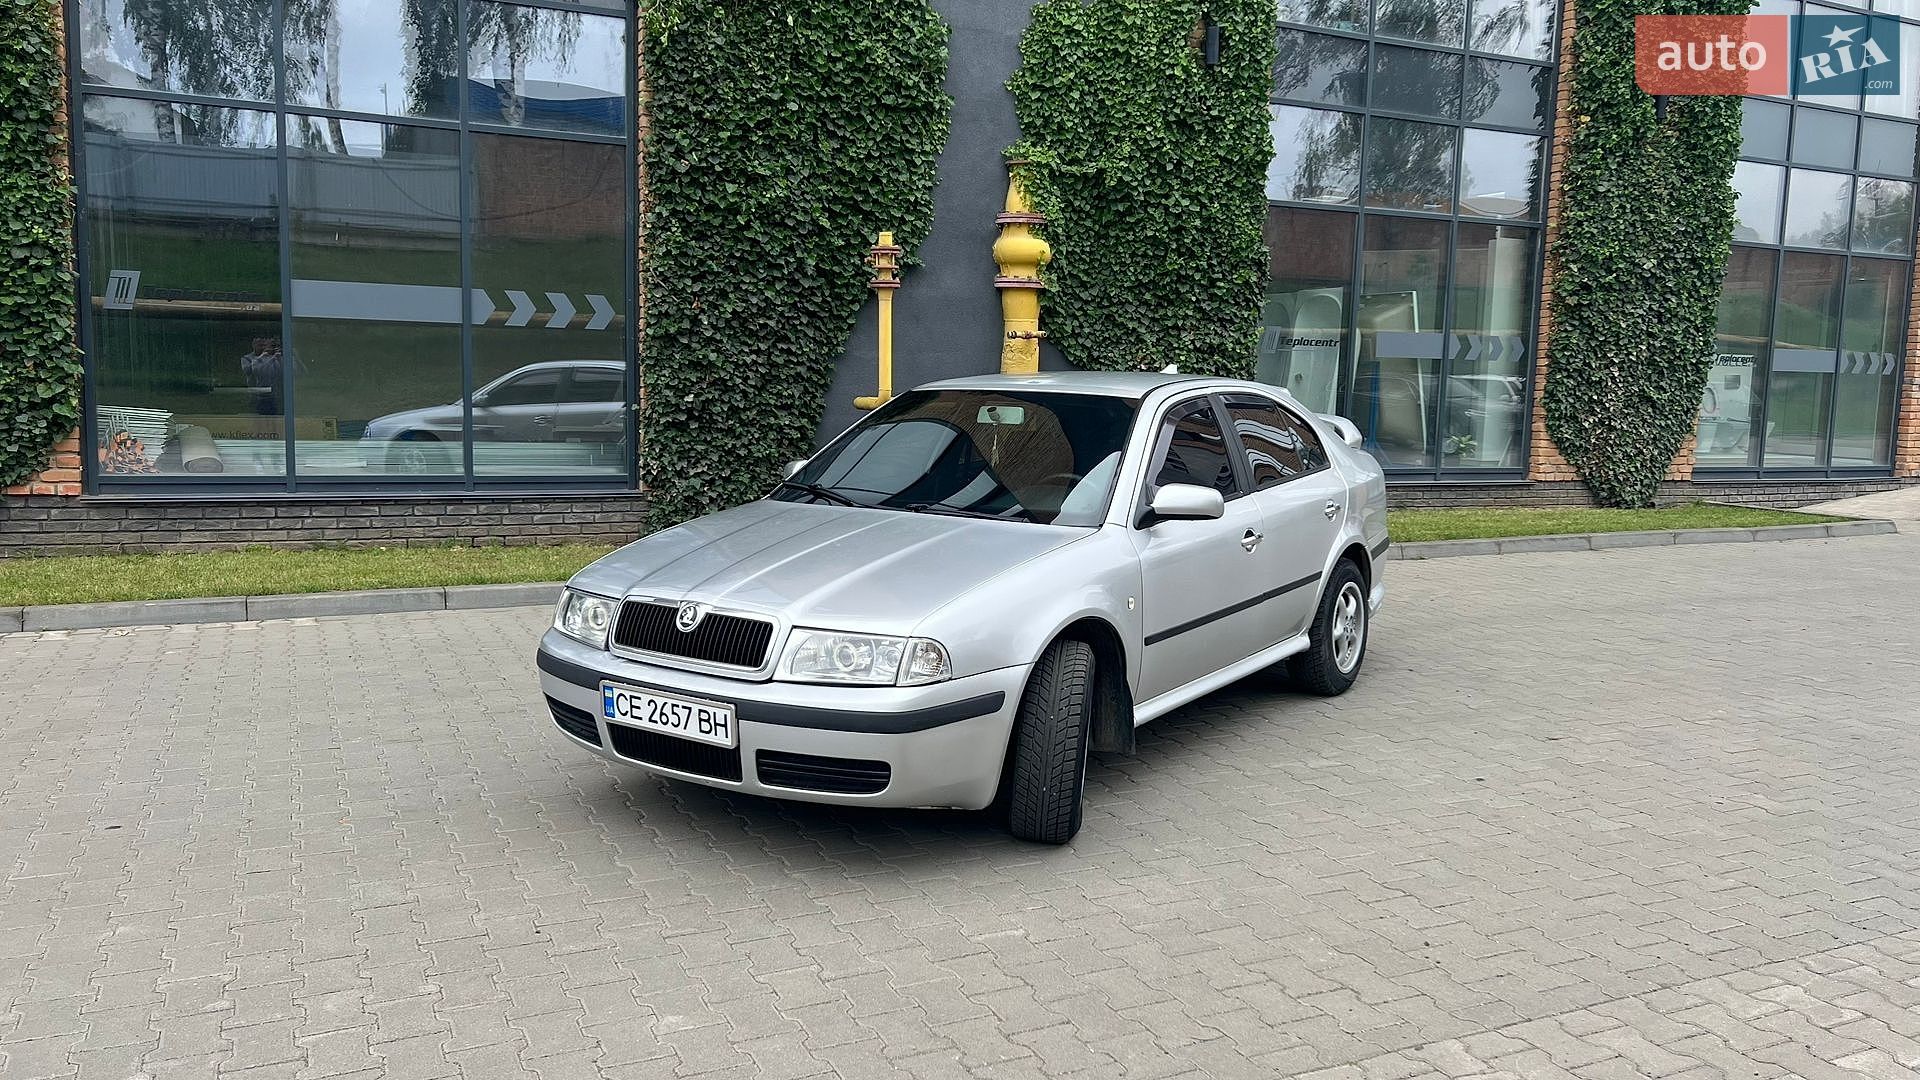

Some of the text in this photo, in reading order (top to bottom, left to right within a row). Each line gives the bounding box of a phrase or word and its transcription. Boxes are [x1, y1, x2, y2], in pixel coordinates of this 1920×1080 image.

[606, 706, 615, 714] UA
[616, 693, 729, 739] CE 2657 BH
